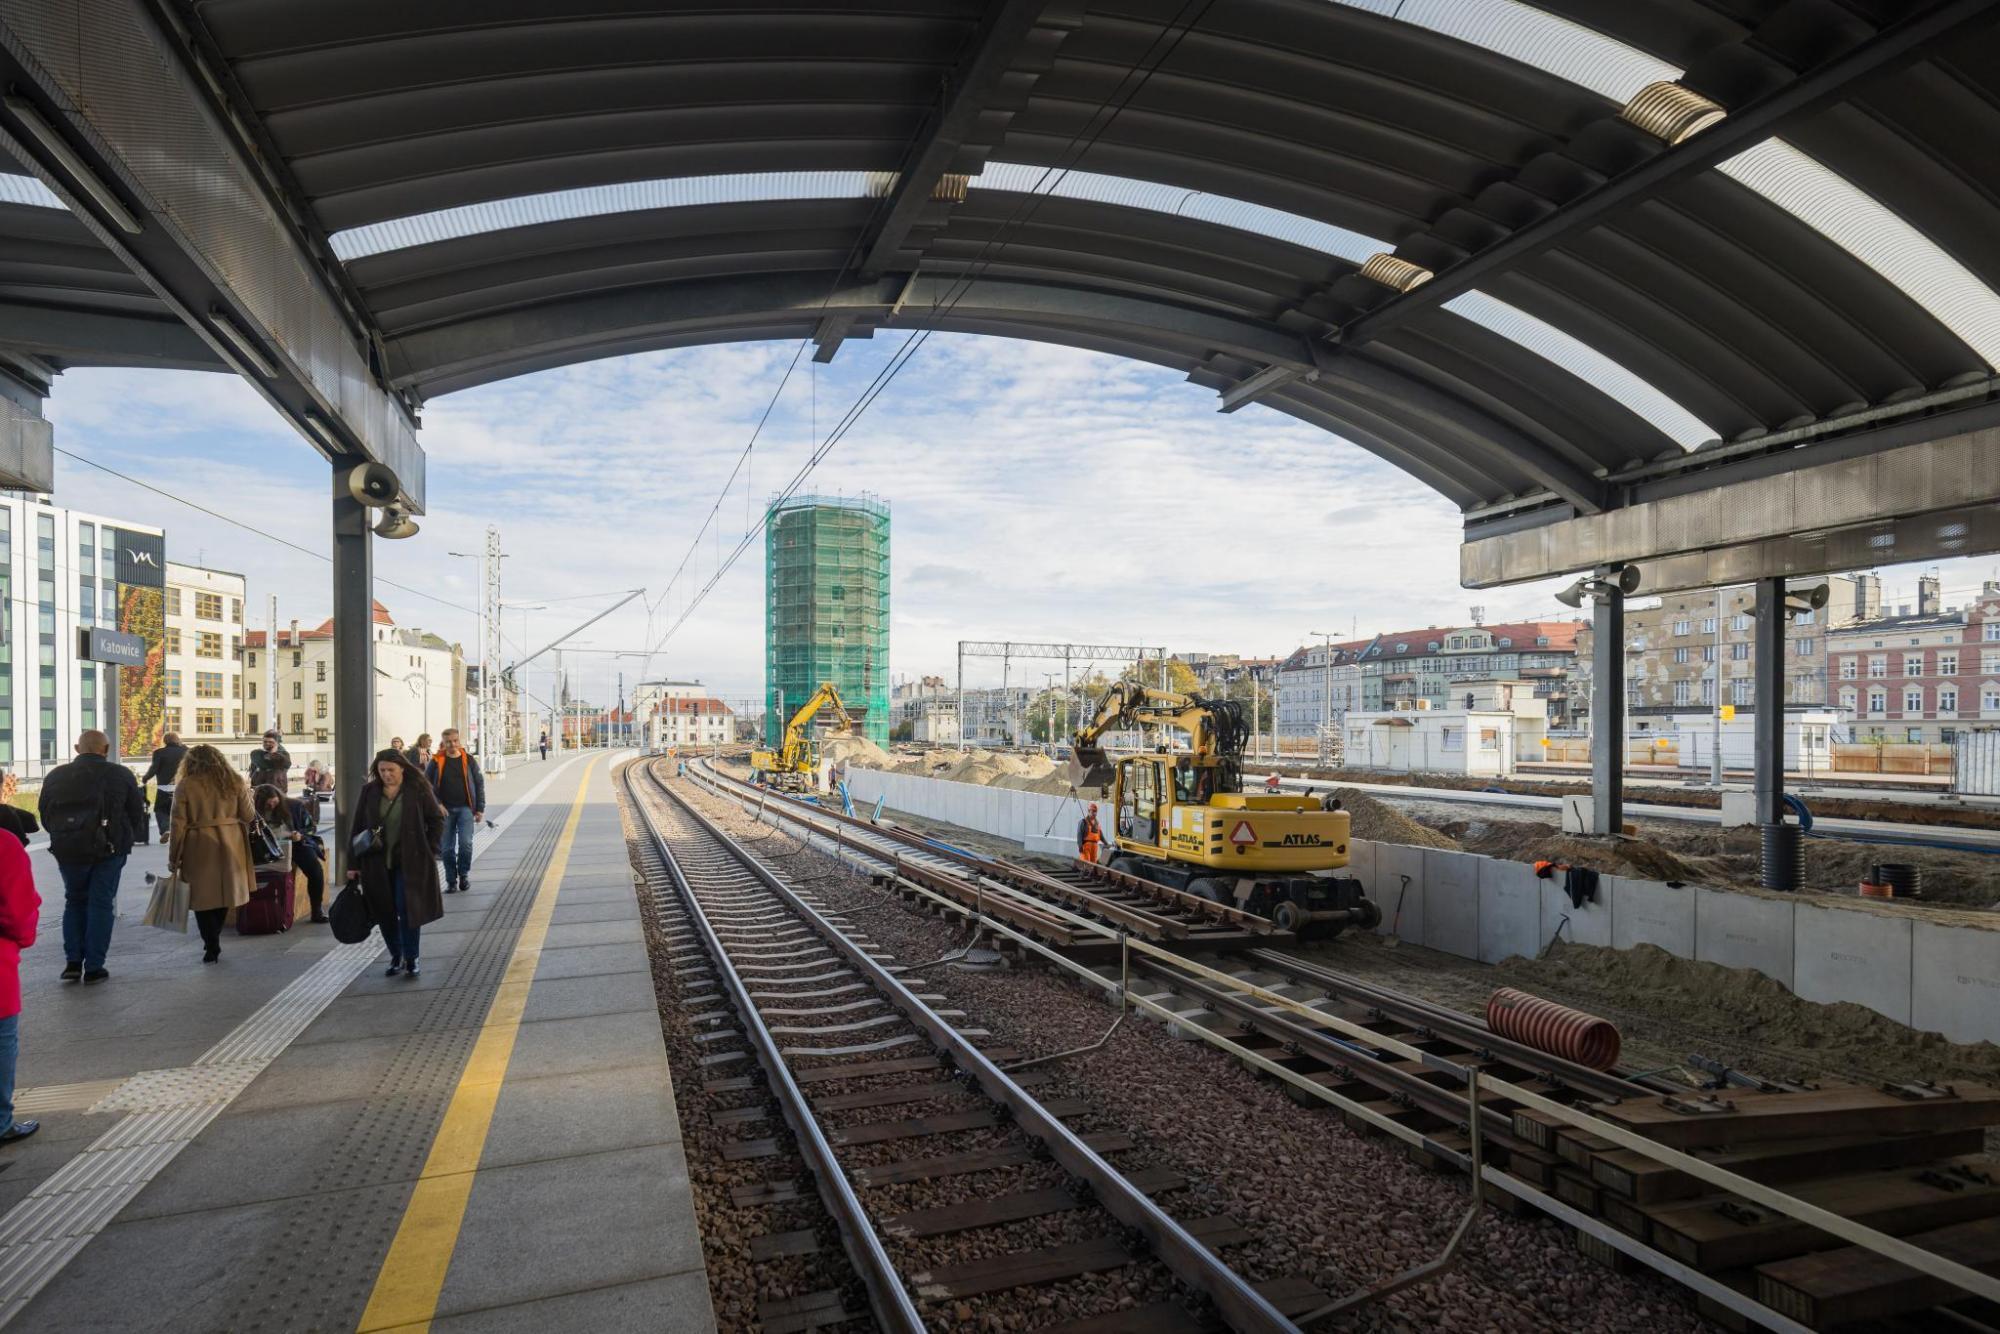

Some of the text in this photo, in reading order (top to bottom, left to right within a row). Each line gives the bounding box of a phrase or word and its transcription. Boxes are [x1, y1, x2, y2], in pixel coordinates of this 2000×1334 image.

[100, 638, 140, 657] Katowice
[1178, 833, 1198, 845] ATLAS
[1283, 834, 1321, 845] ATLAS
